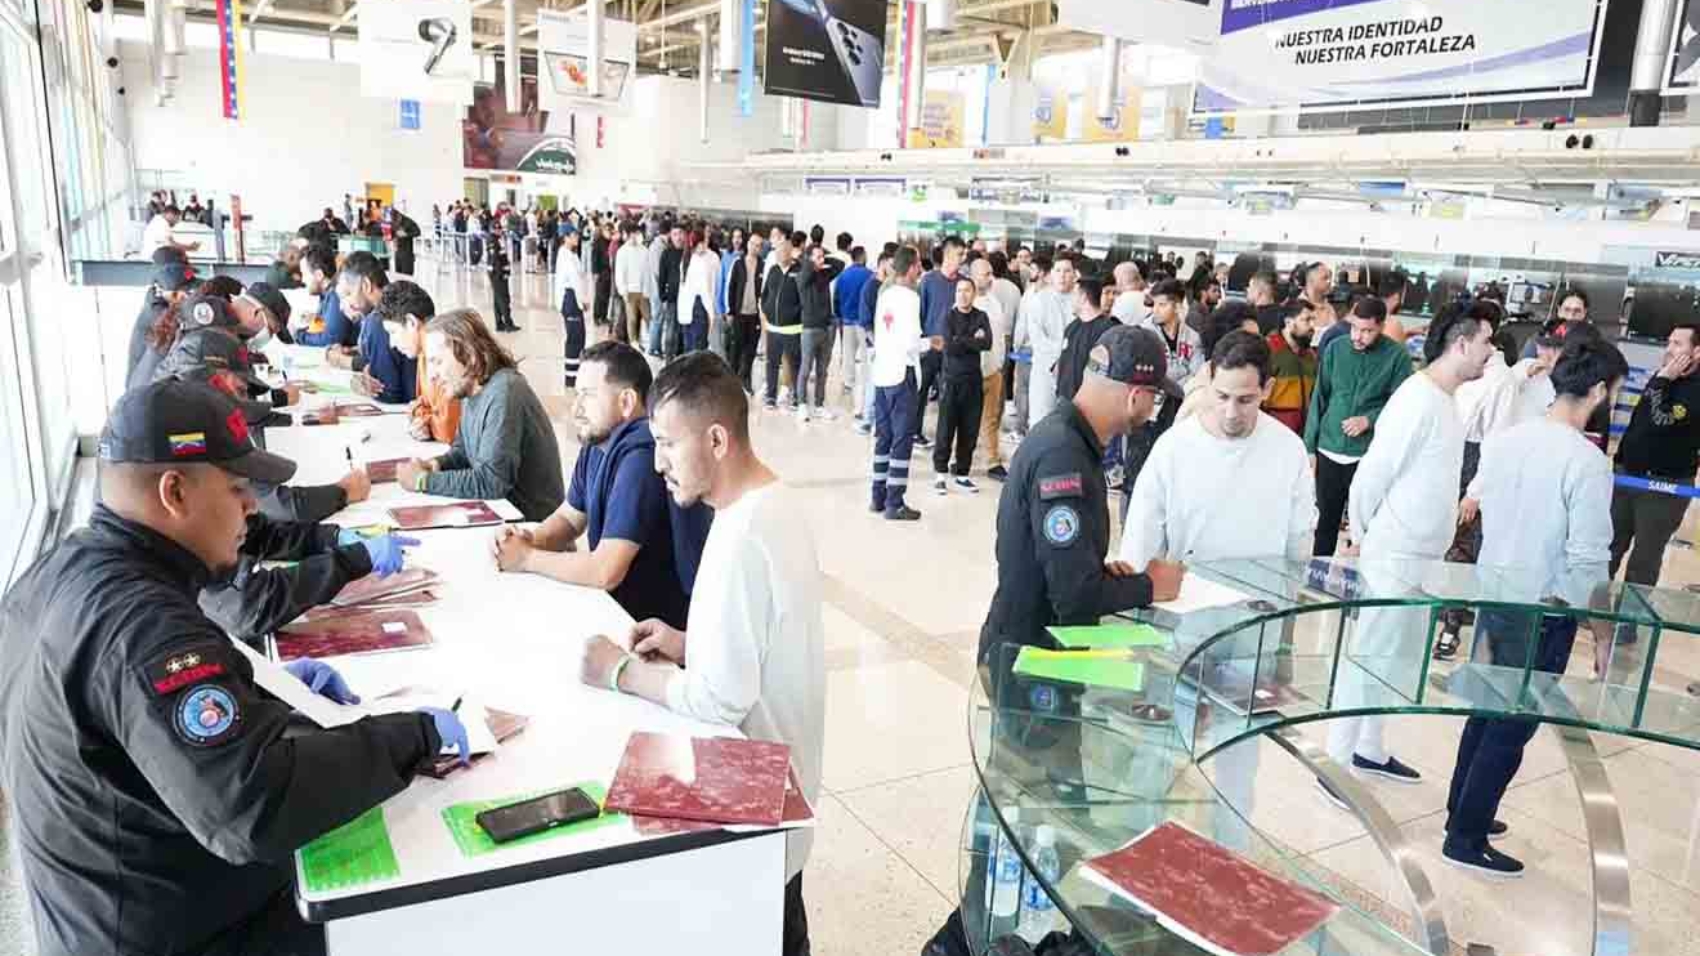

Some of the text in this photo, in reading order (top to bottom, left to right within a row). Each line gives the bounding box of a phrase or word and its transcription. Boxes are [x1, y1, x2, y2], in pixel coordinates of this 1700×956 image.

[1275, 16, 1443, 48] NUESTRA IDENTIDAD
[1295, 34, 1475, 65] NUESTRA FORTALEZA
[1648, 479, 1678, 494] SAIME
